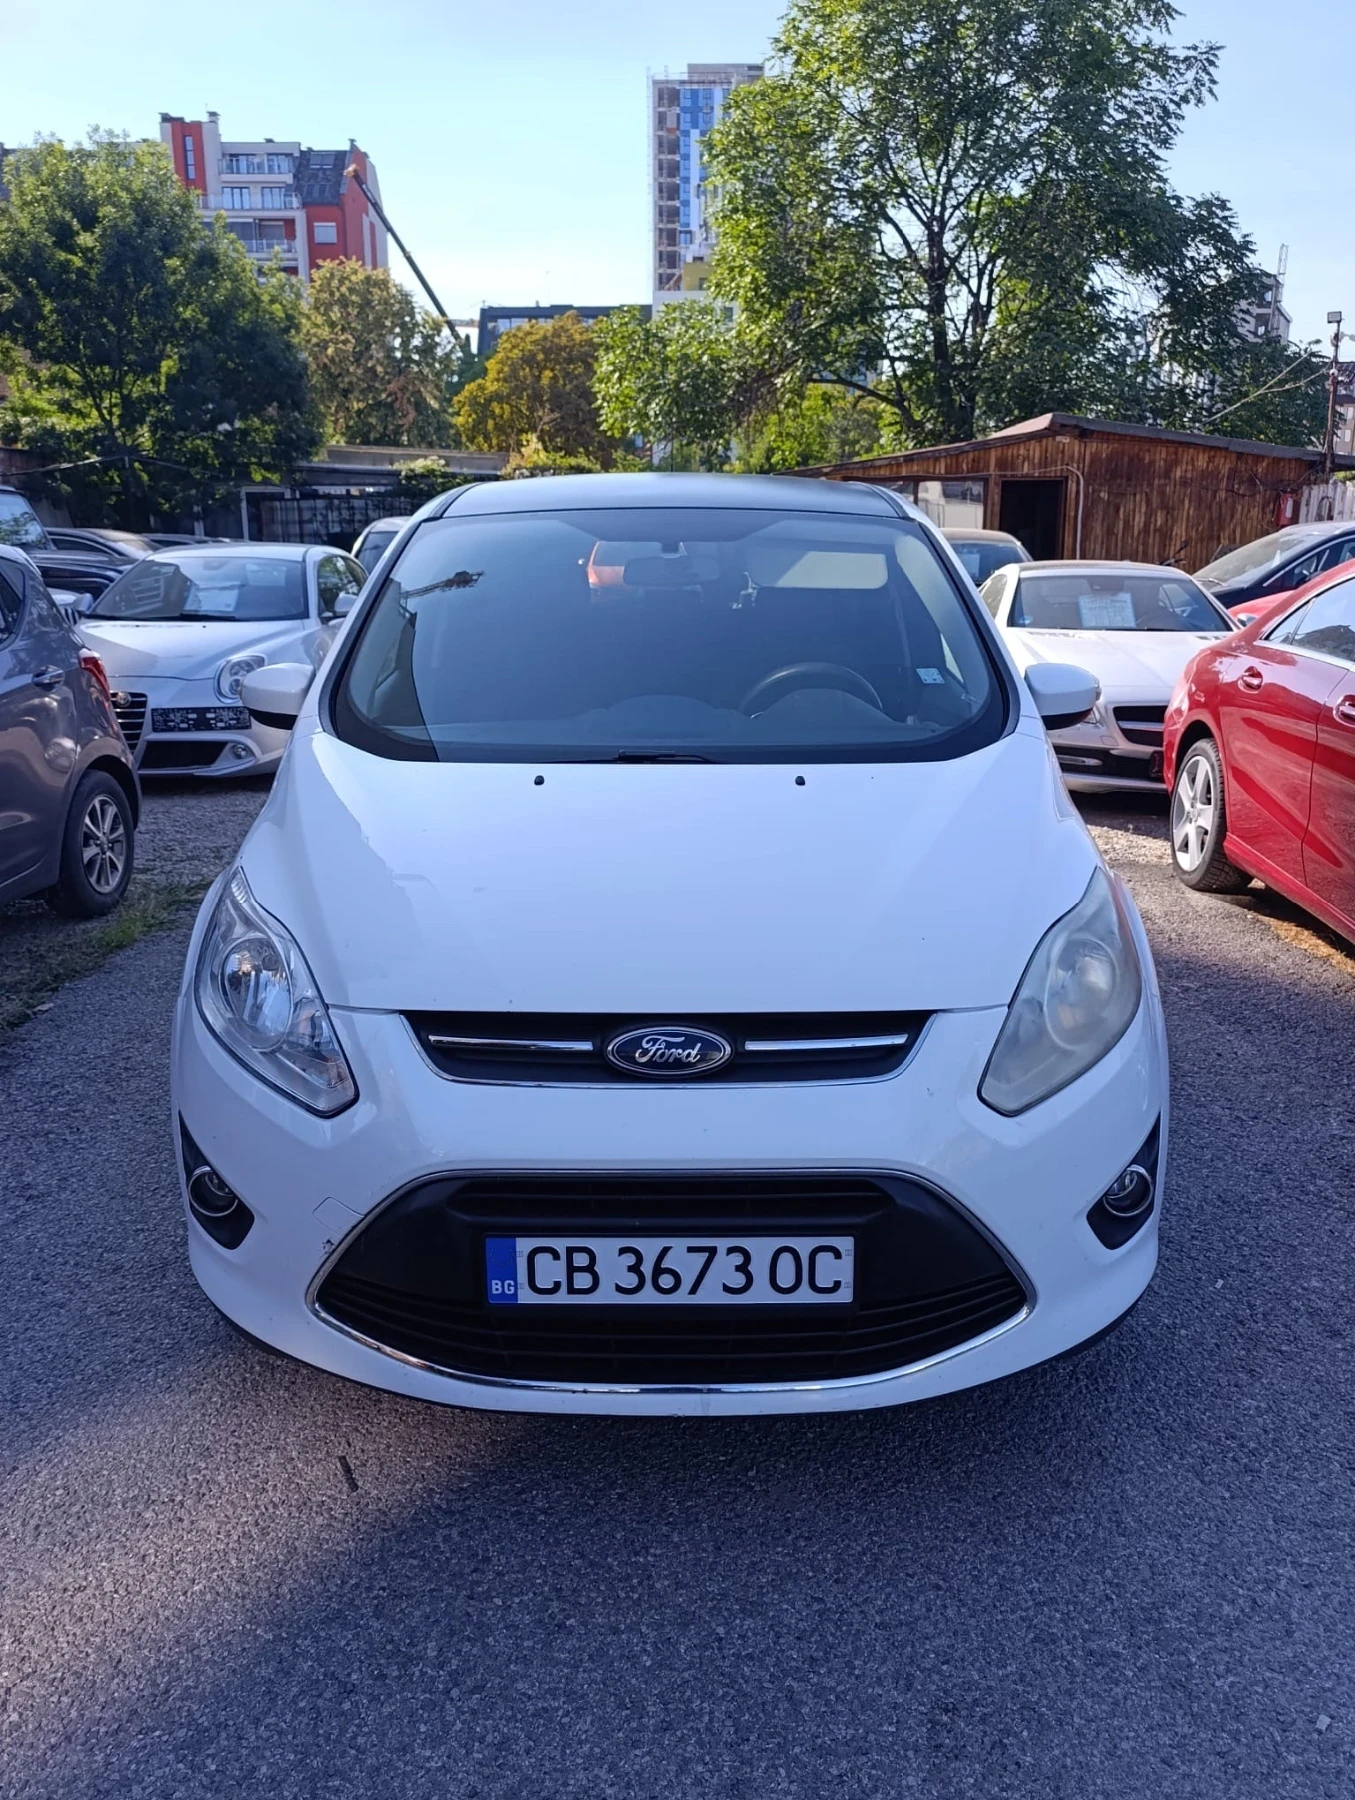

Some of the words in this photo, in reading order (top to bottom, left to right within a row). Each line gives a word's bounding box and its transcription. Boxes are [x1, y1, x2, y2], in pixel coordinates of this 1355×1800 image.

[635, 1035, 702, 1063] Ford
[526, 1245, 600, 1296] CB
[614, 1245, 754, 1296] 3673
[491, 1280, 515, 1295] BG
